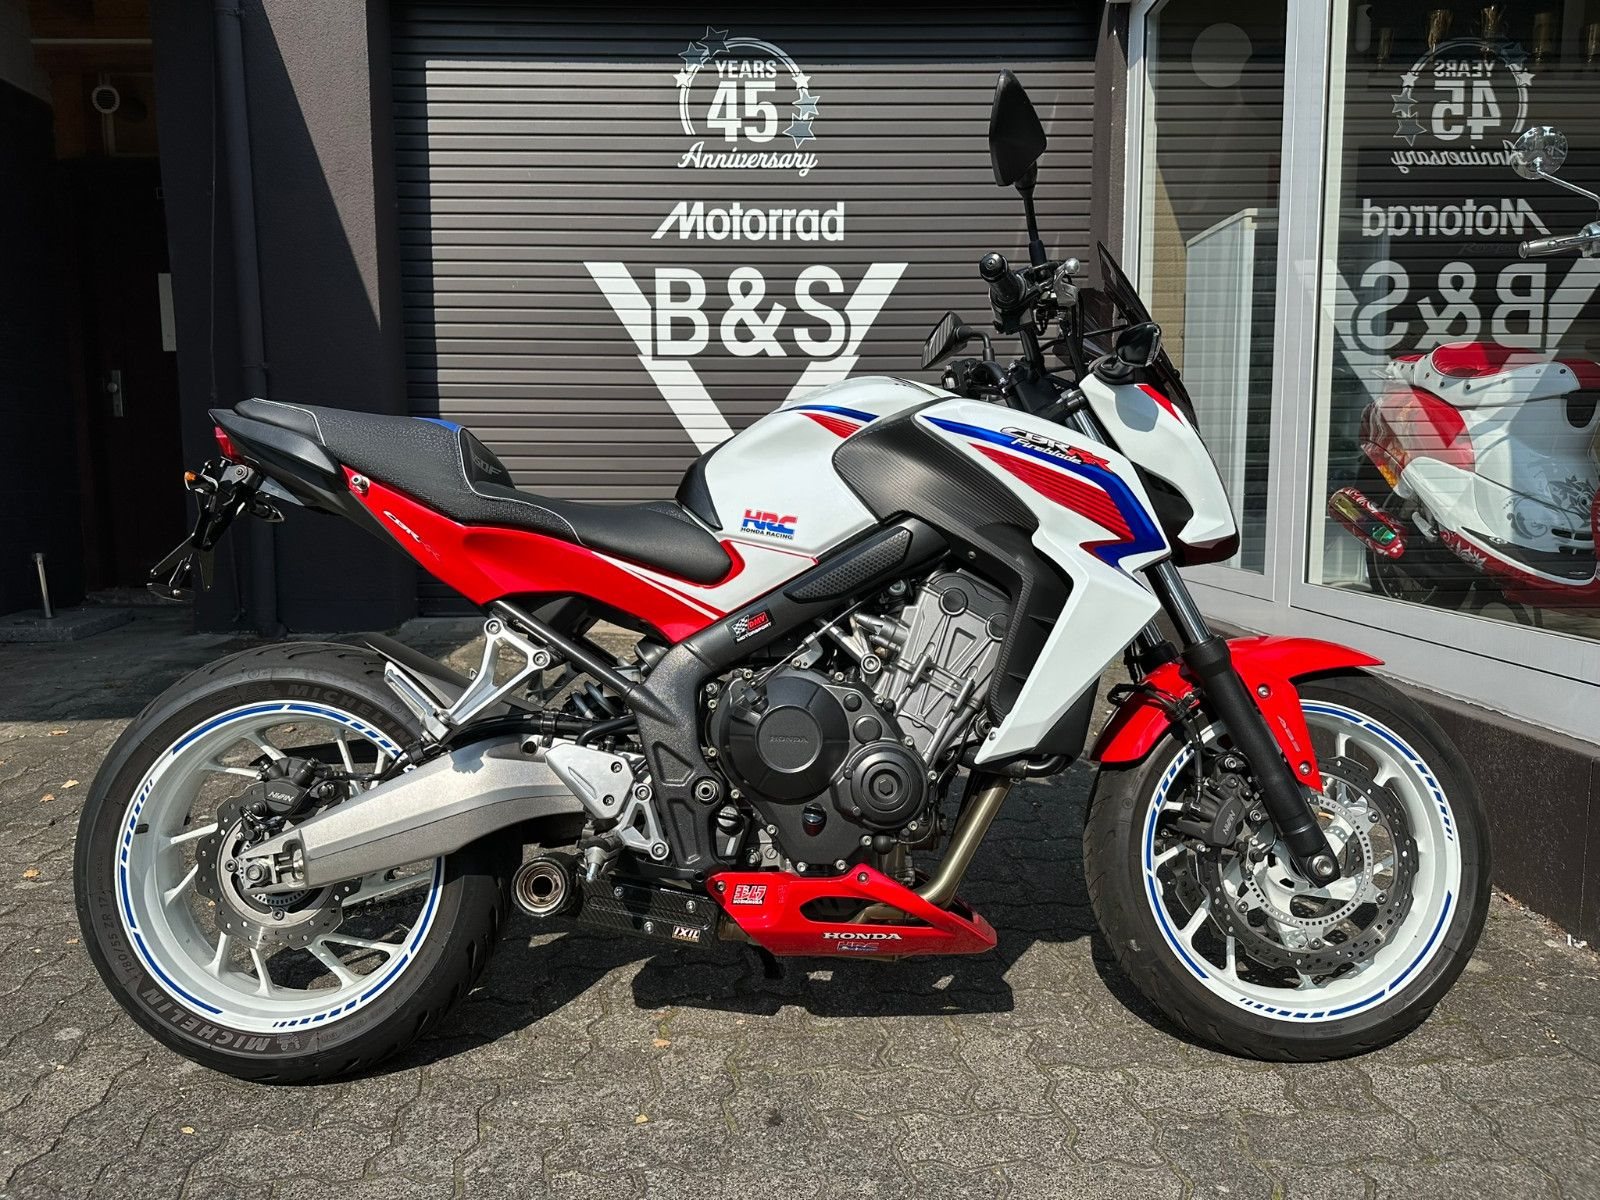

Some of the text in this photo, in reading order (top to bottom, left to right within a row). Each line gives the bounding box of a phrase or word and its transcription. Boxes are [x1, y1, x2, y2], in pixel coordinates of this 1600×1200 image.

[715, 60, 777, 79] YEARS
[707, 80, 778, 143] 45
[677, 141, 818, 177] Anniversary
[651, 201, 845, 241] Motorrad
[655, 265, 847, 357] B&S
[1011, 437, 1081, 465] Fireblade
[741, 527, 793, 540] HONDA RACING
[742, 509, 798, 535] HRC
[750, 615, 766, 628] DMV
[287, 684, 416, 746] MICHELIN
[769, 735, 809, 744] HONDA
[823, 932, 902, 940] HONDA
[142, 988, 271, 1051] MICHELIN
